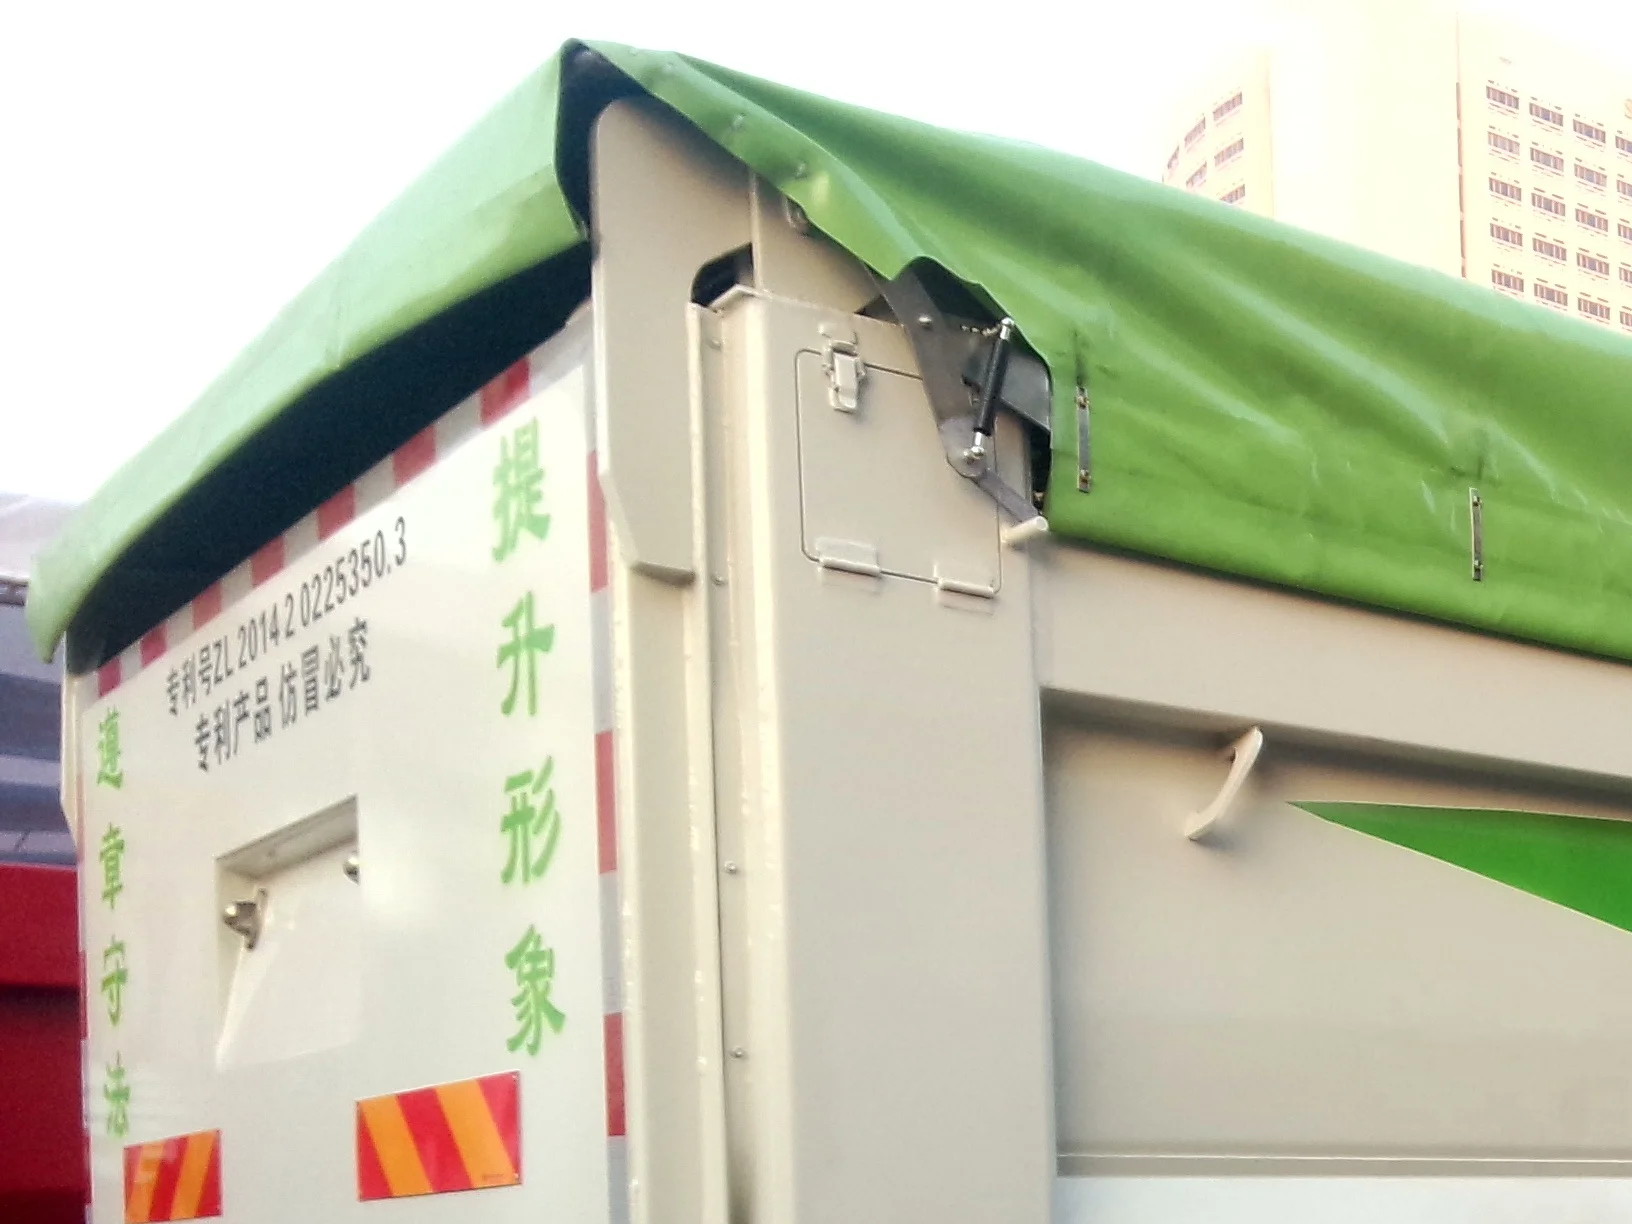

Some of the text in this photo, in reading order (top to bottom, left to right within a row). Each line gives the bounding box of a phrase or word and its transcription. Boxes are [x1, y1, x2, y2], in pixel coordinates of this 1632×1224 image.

[300, 515, 407, 628] 0225350.3
[491, 416, 566, 1058] 提升形象
